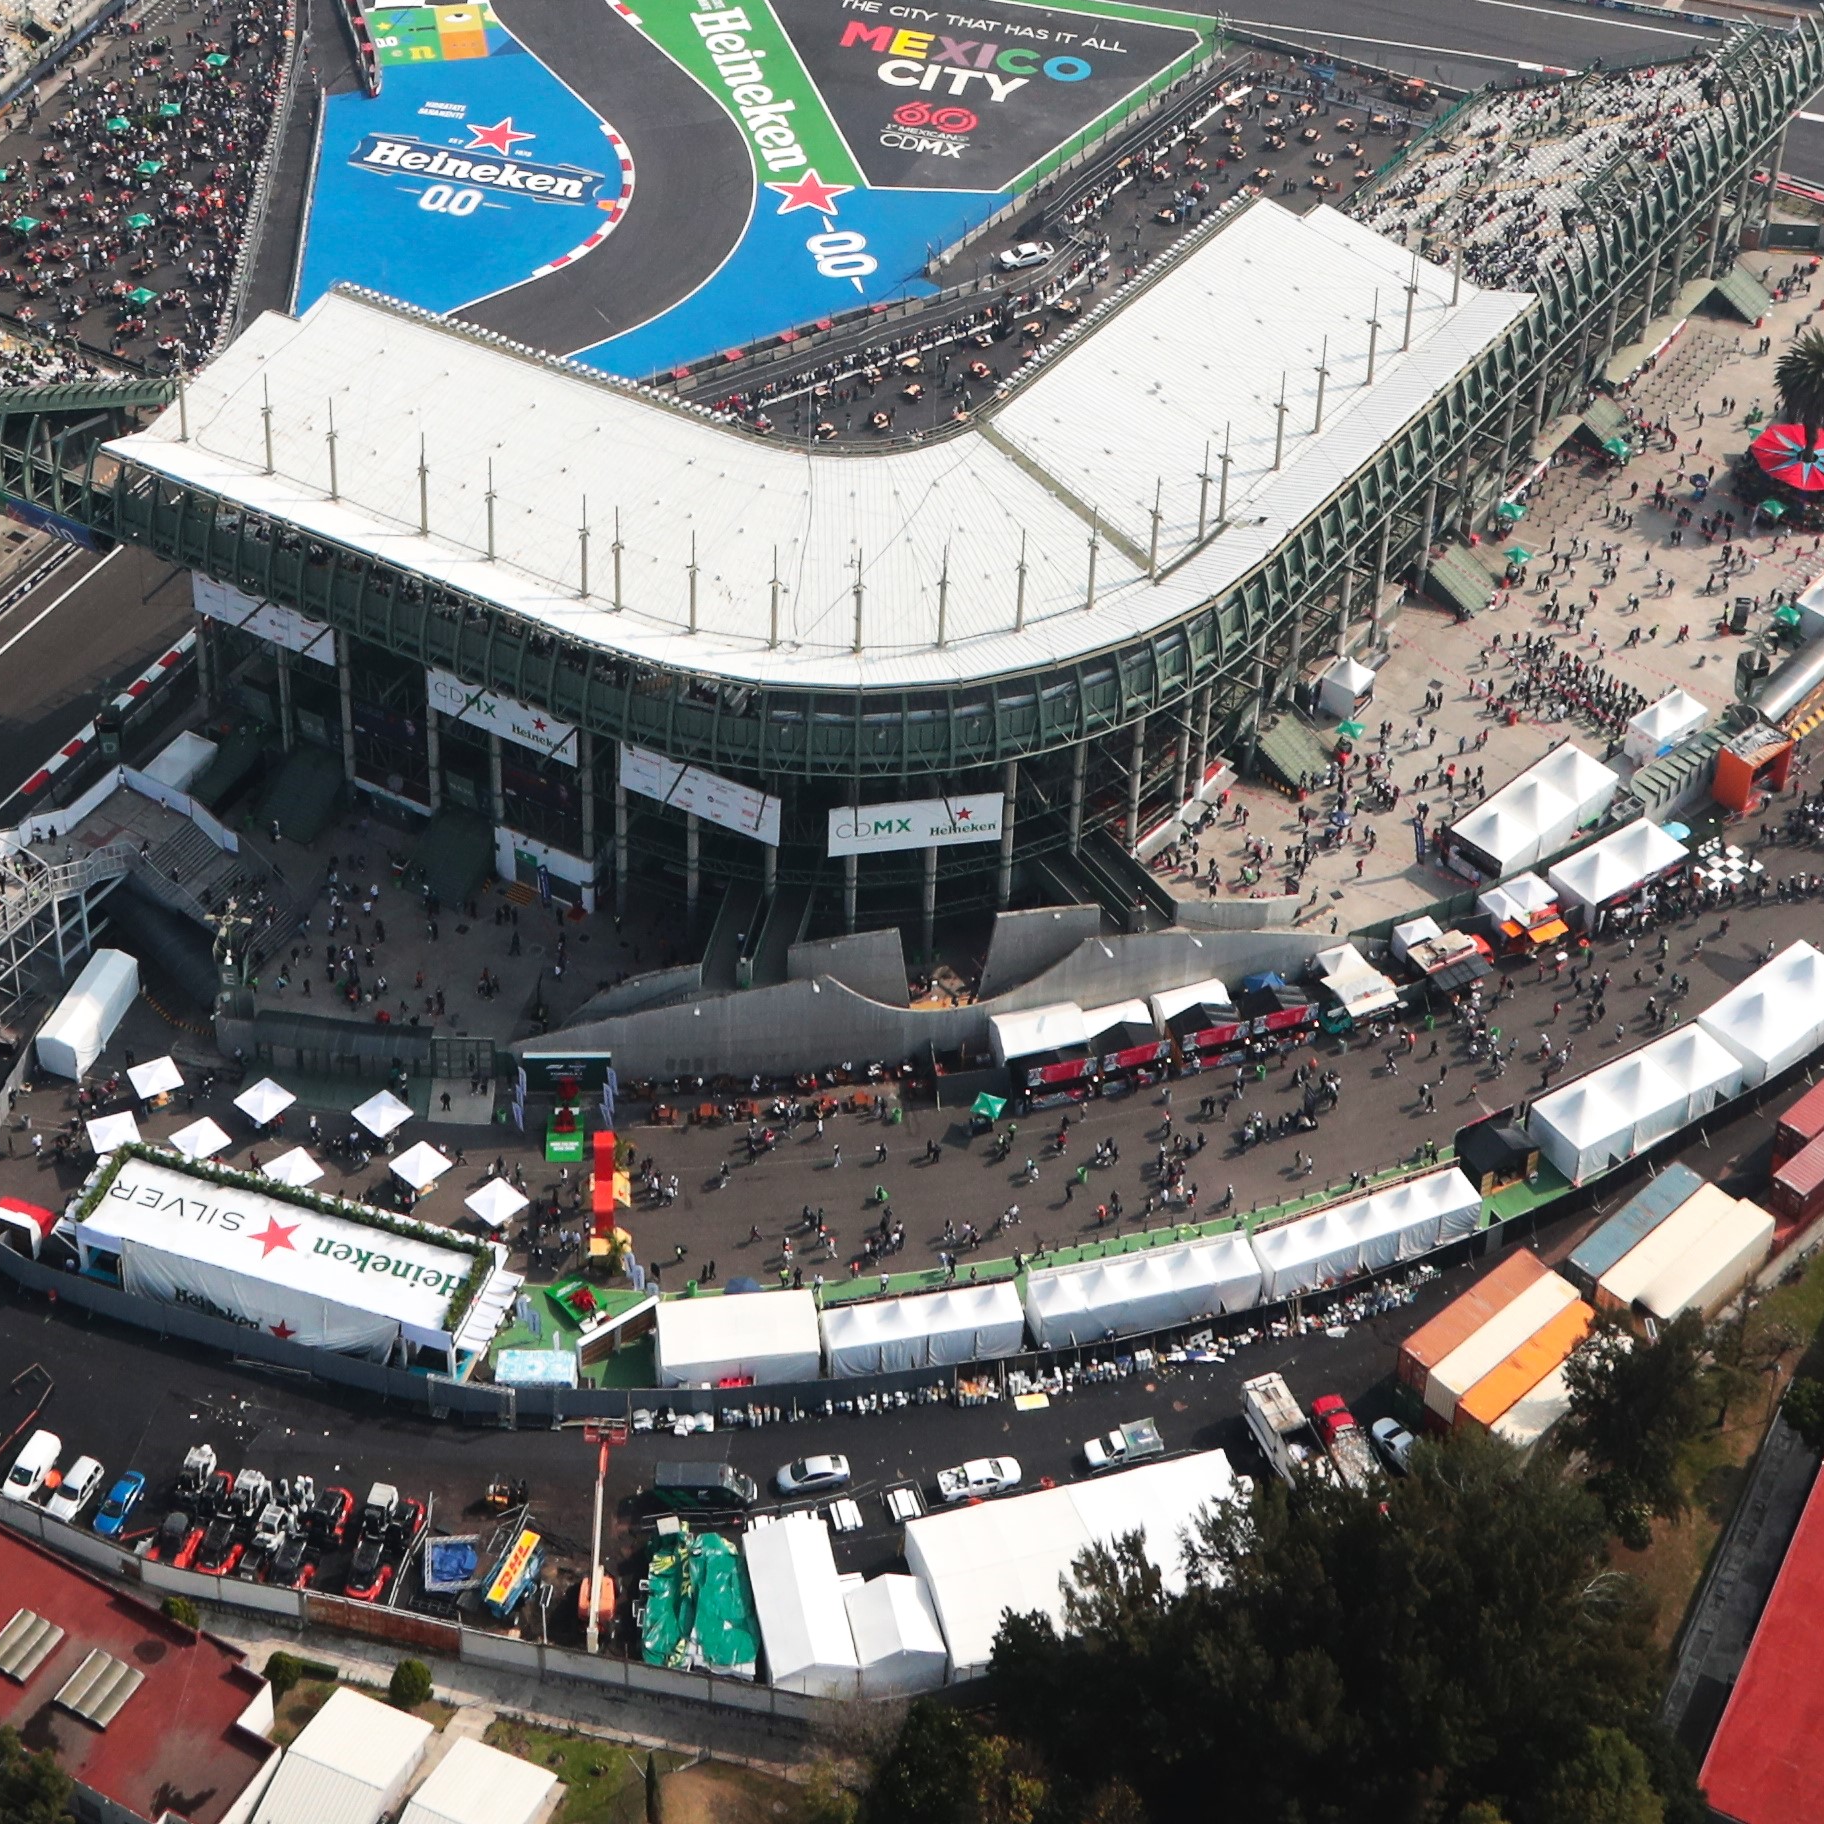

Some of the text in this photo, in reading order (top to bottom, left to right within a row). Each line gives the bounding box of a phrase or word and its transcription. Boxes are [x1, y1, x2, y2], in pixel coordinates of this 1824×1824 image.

[889, 5, 939, 21] CITY
[946, 14, 1001, 32] THAT
[1004, 23, 1049, 40] HAS
[1055, 32, 1078, 44] IT
[1082, 37, 1127, 53] ALL
[839, 20, 1092, 82] MEXICO
[877, 59, 1029, 102] CITY
[893, 101, 979, 133] 60
[689, 6, 877, 278] Heineken 0.0
[880, 133, 965, 159] CDMX
[363, 141, 583, 199] Heineken
[418, 184, 484, 217] 0.0
[434, 681, 497, 719] CDMX
[1751, 685, 1763, 698] F
[511, 723, 569, 755] Heineken
[836, 817, 997, 839] CDMX Heineken
[222, 972, 234, 985] E
[110, 1179, 245, 1231] SILVER
[312, 1236, 470, 1298] Heineken
[498, 1544, 530, 1590] DHL
